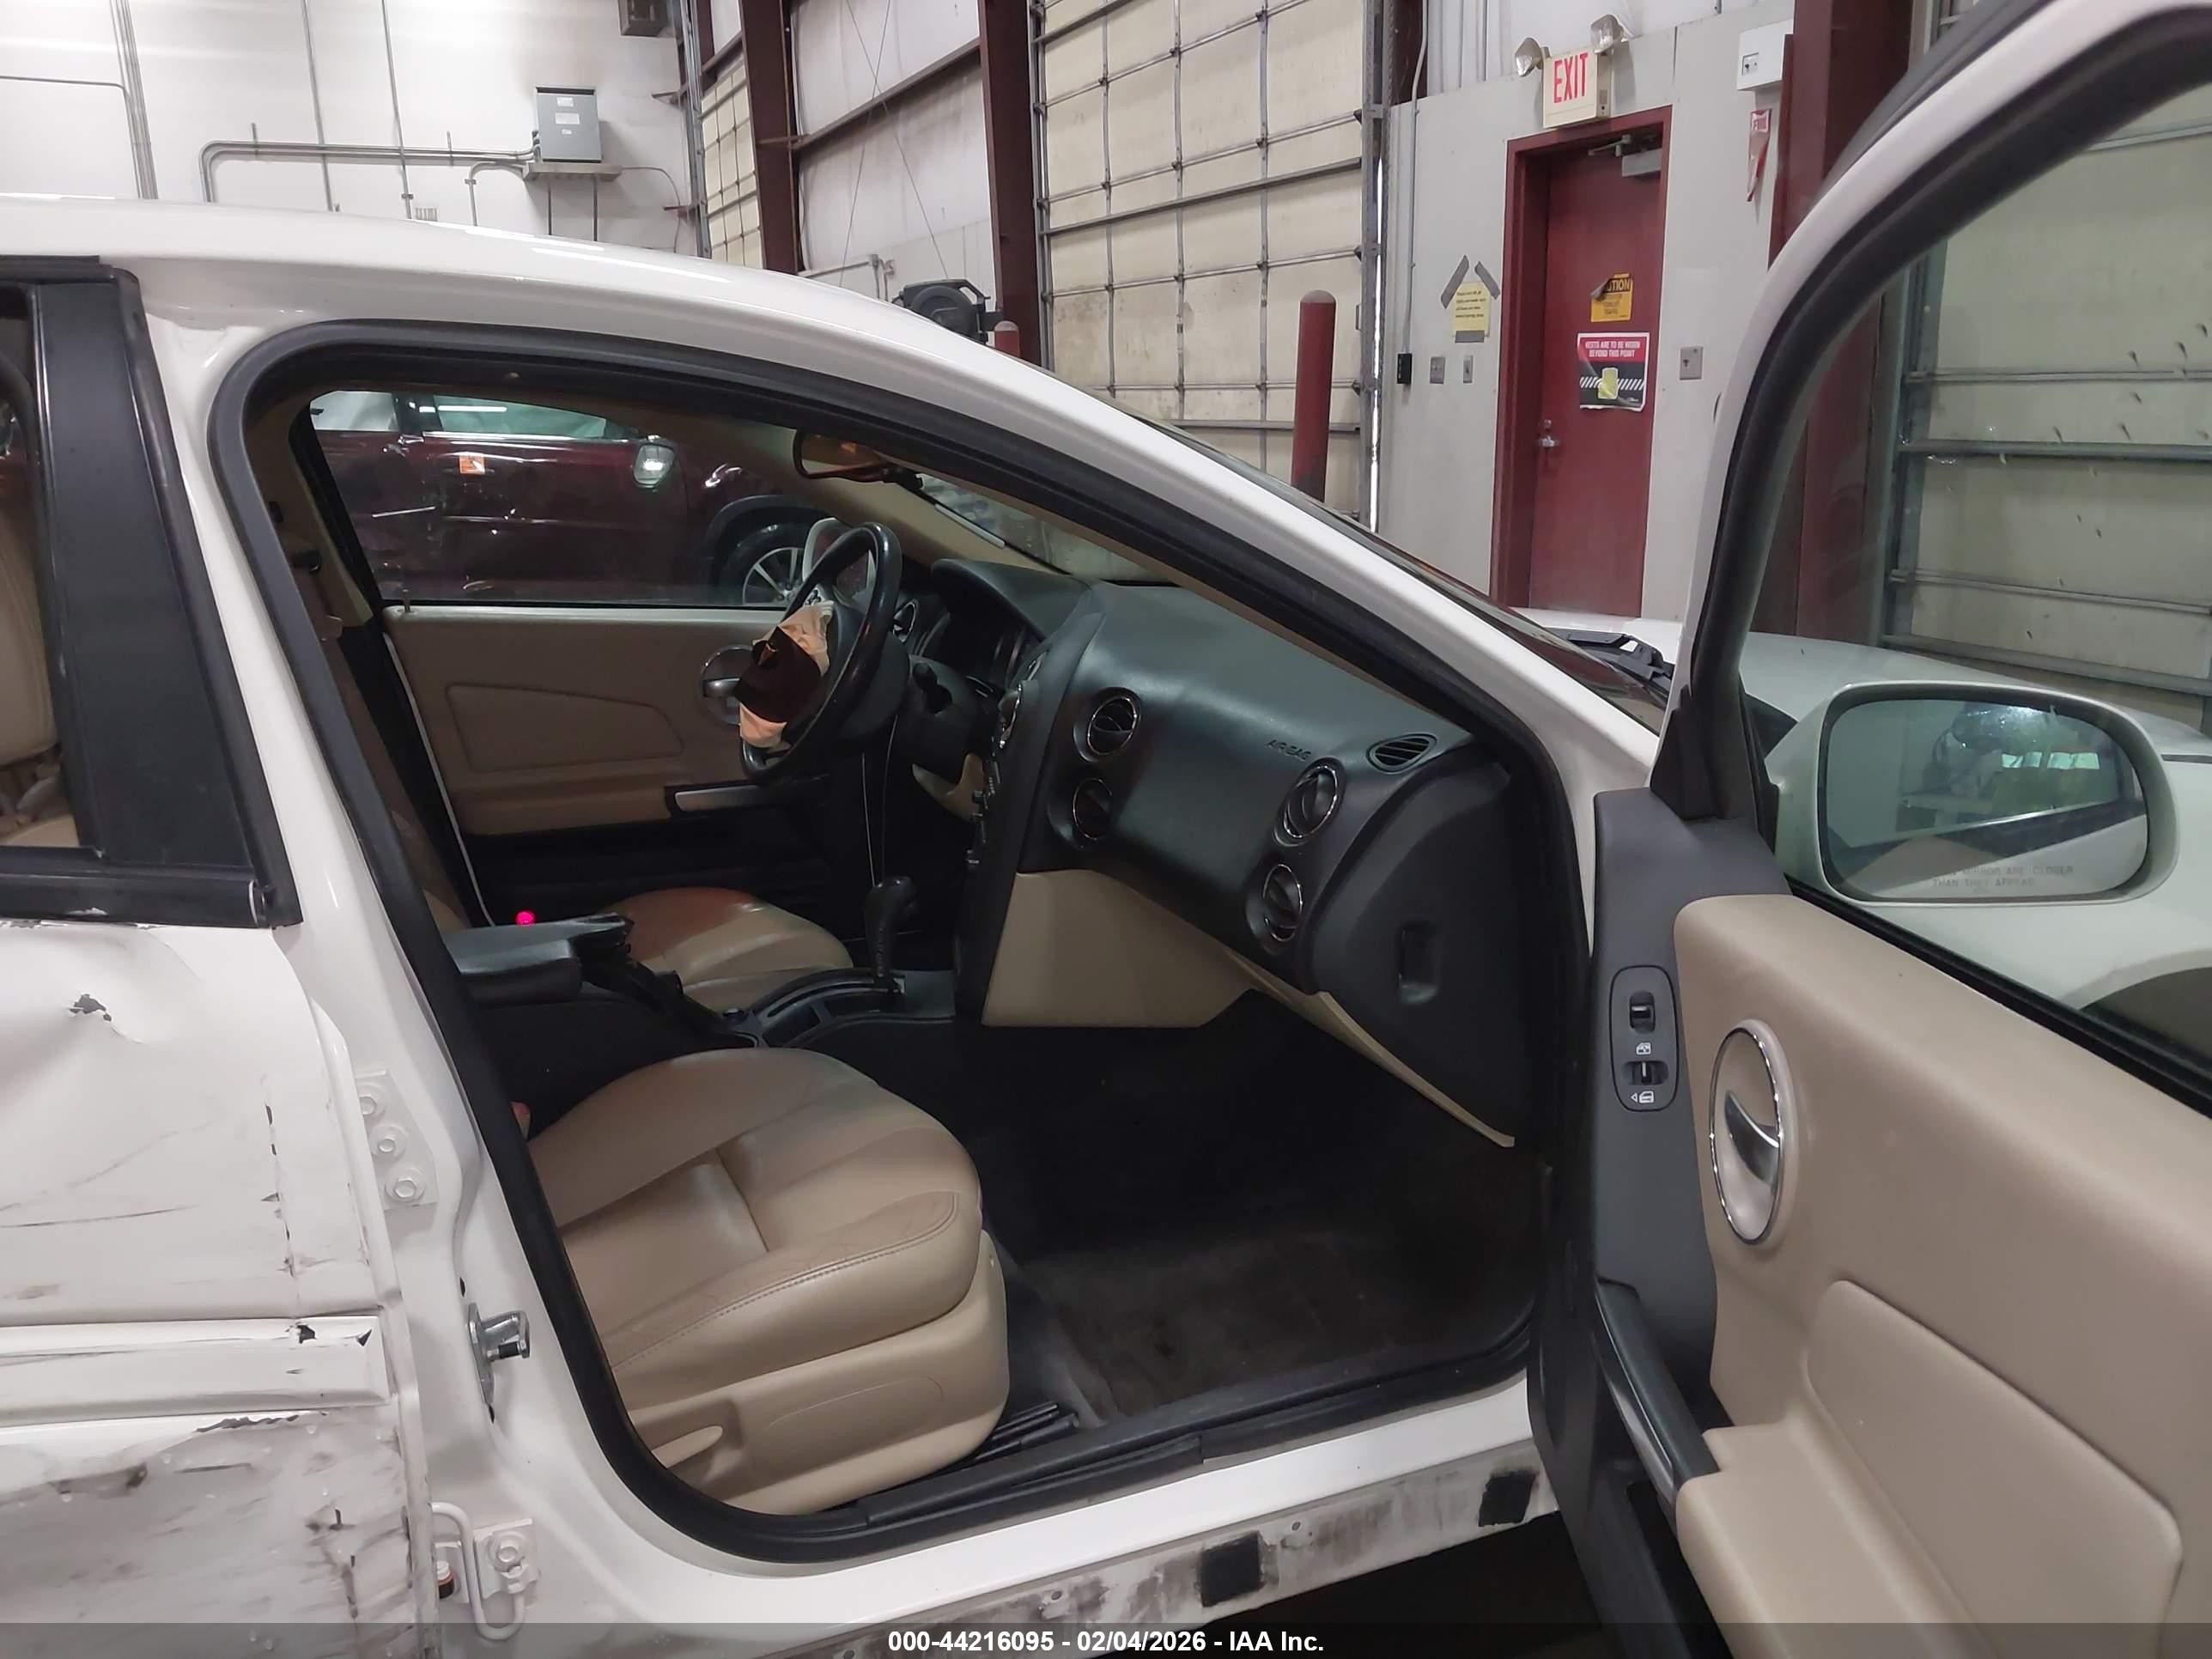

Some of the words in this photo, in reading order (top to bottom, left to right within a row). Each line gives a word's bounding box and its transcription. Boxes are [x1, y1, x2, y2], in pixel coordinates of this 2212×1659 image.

[1554, 52, 1588, 103] EXIT
[1607, 278, 1630, 292] UTION
[1933, 878, 1958, 887] THAN
